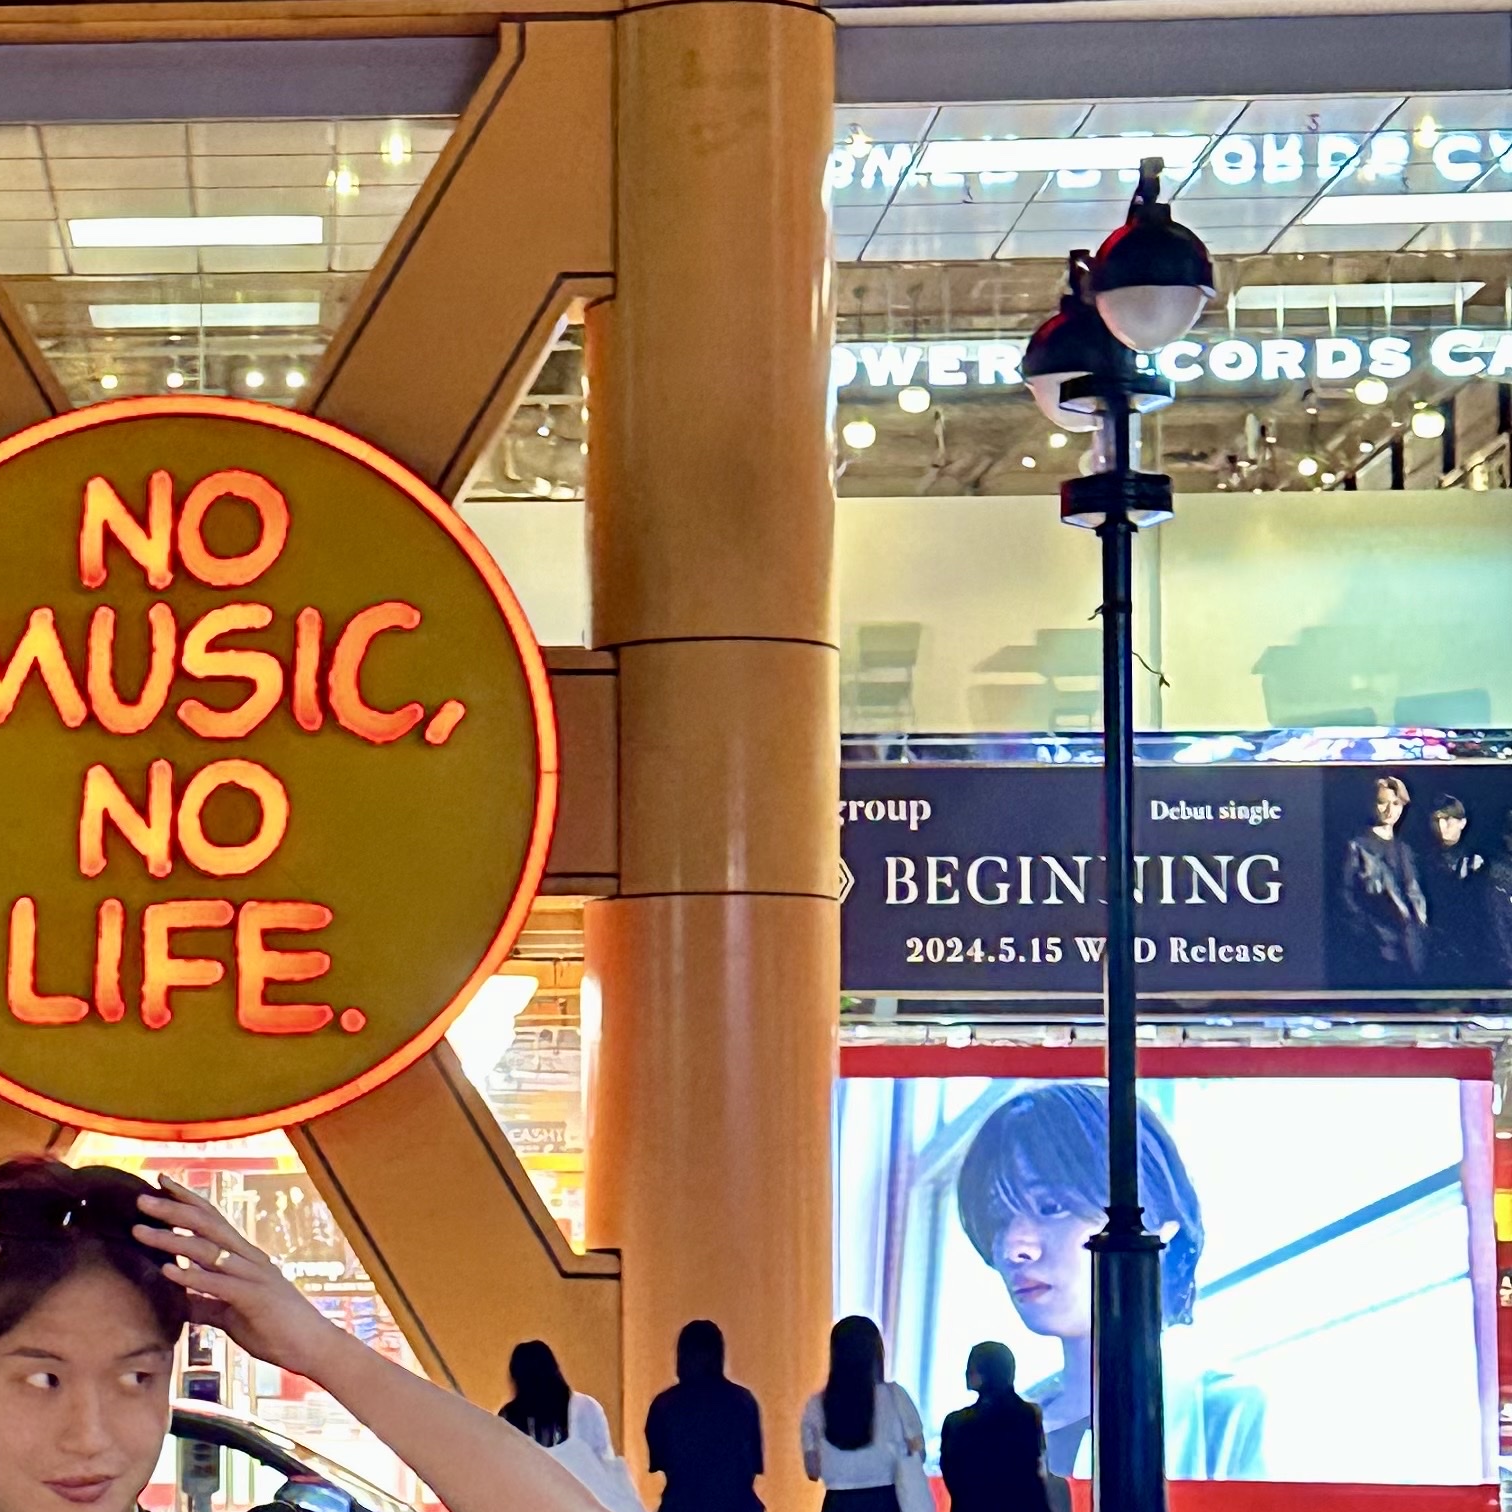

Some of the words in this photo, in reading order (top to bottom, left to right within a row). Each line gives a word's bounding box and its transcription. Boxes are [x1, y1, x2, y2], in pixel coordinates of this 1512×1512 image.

[833, 344, 1025, 387] OWER
[1136, 337, 1412, 382] CORDS
[79, 468, 290, 590] NO
[79, 758, 290, 878] NO
[1150, 799, 1214, 821] Debut
[1219, 798, 1283, 826] single
[7, 897, 367, 1034] LIFE.
[905, 937, 1063, 964] 2024.5.15
[1074, 936, 1157, 964] WD
[1169, 936, 1284, 964] Release
